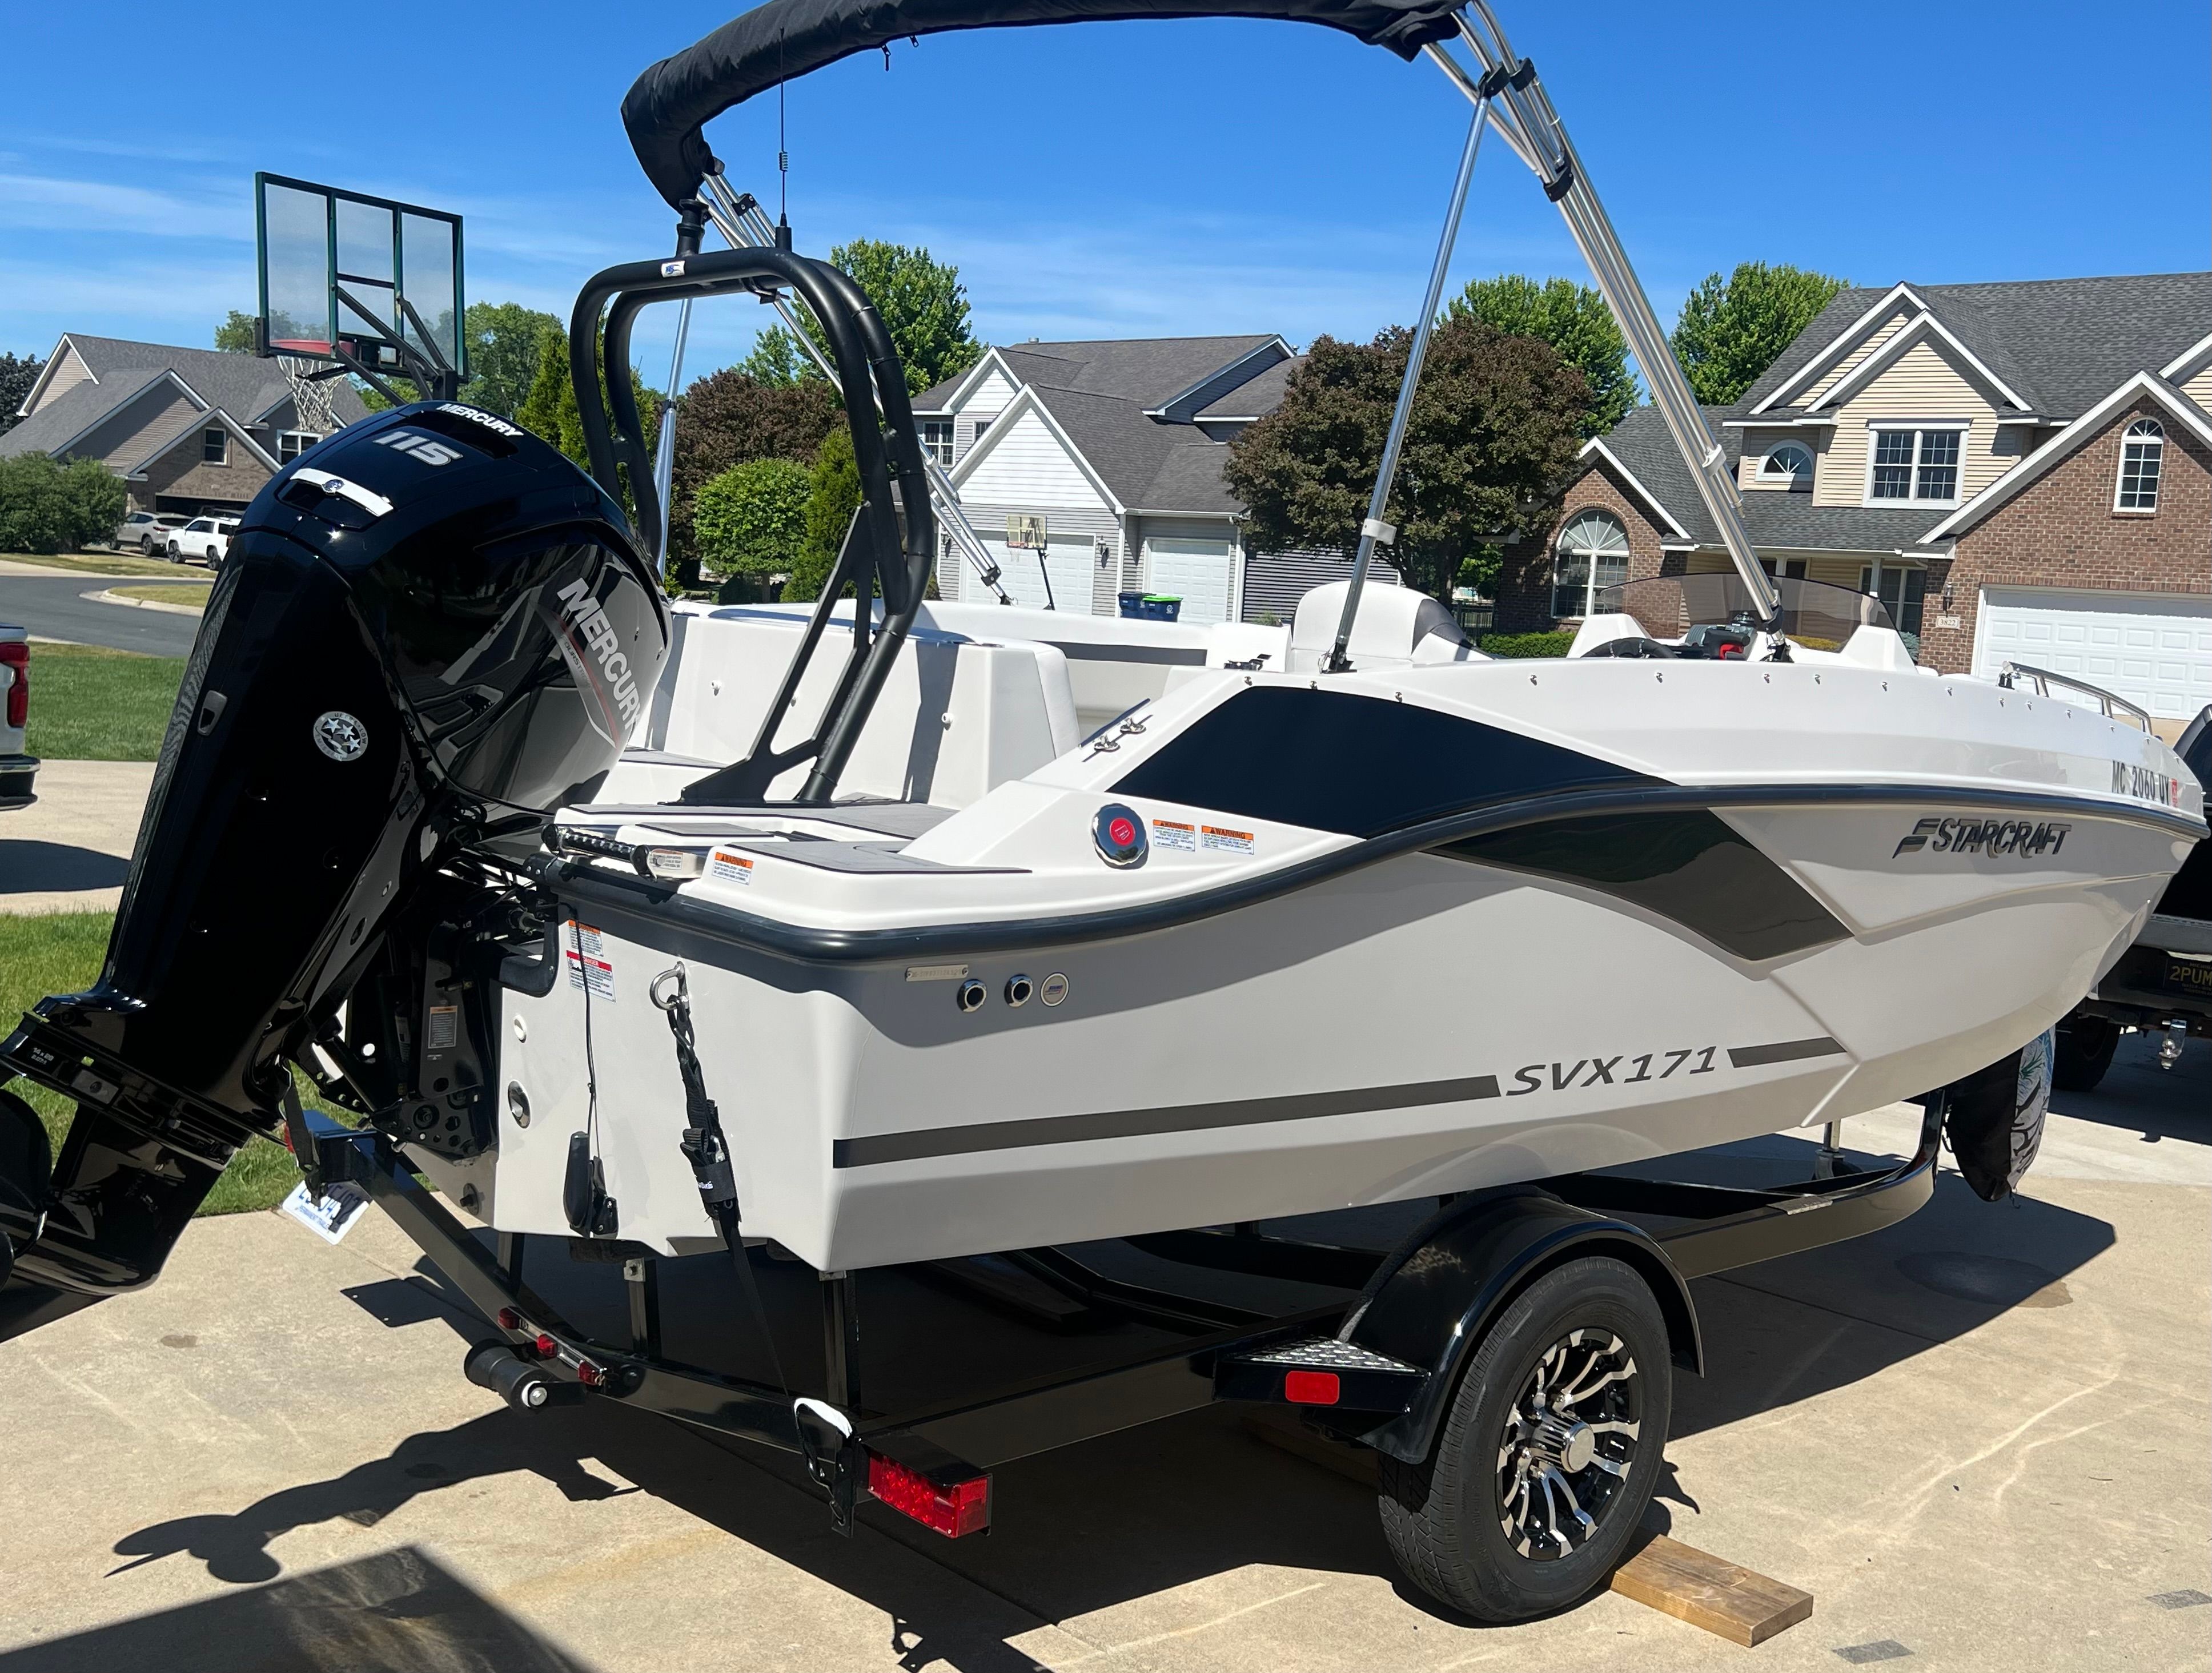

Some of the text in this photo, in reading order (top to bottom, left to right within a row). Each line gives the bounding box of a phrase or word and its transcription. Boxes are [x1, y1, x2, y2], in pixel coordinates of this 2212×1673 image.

[436, 403, 524, 436] MERCURY
[372, 431, 464, 466] 115
[557, 577, 641, 730] MERCURY
[2111, 760, 2126, 794] MC
[2132, 766, 2156, 802] 2060
[2158, 774, 2169, 806] UY
[1215, 827, 1246, 839] WARNING
[1933, 818, 2072, 859] STARCRAFT
[2170, 966, 2212, 987] 2PUM
